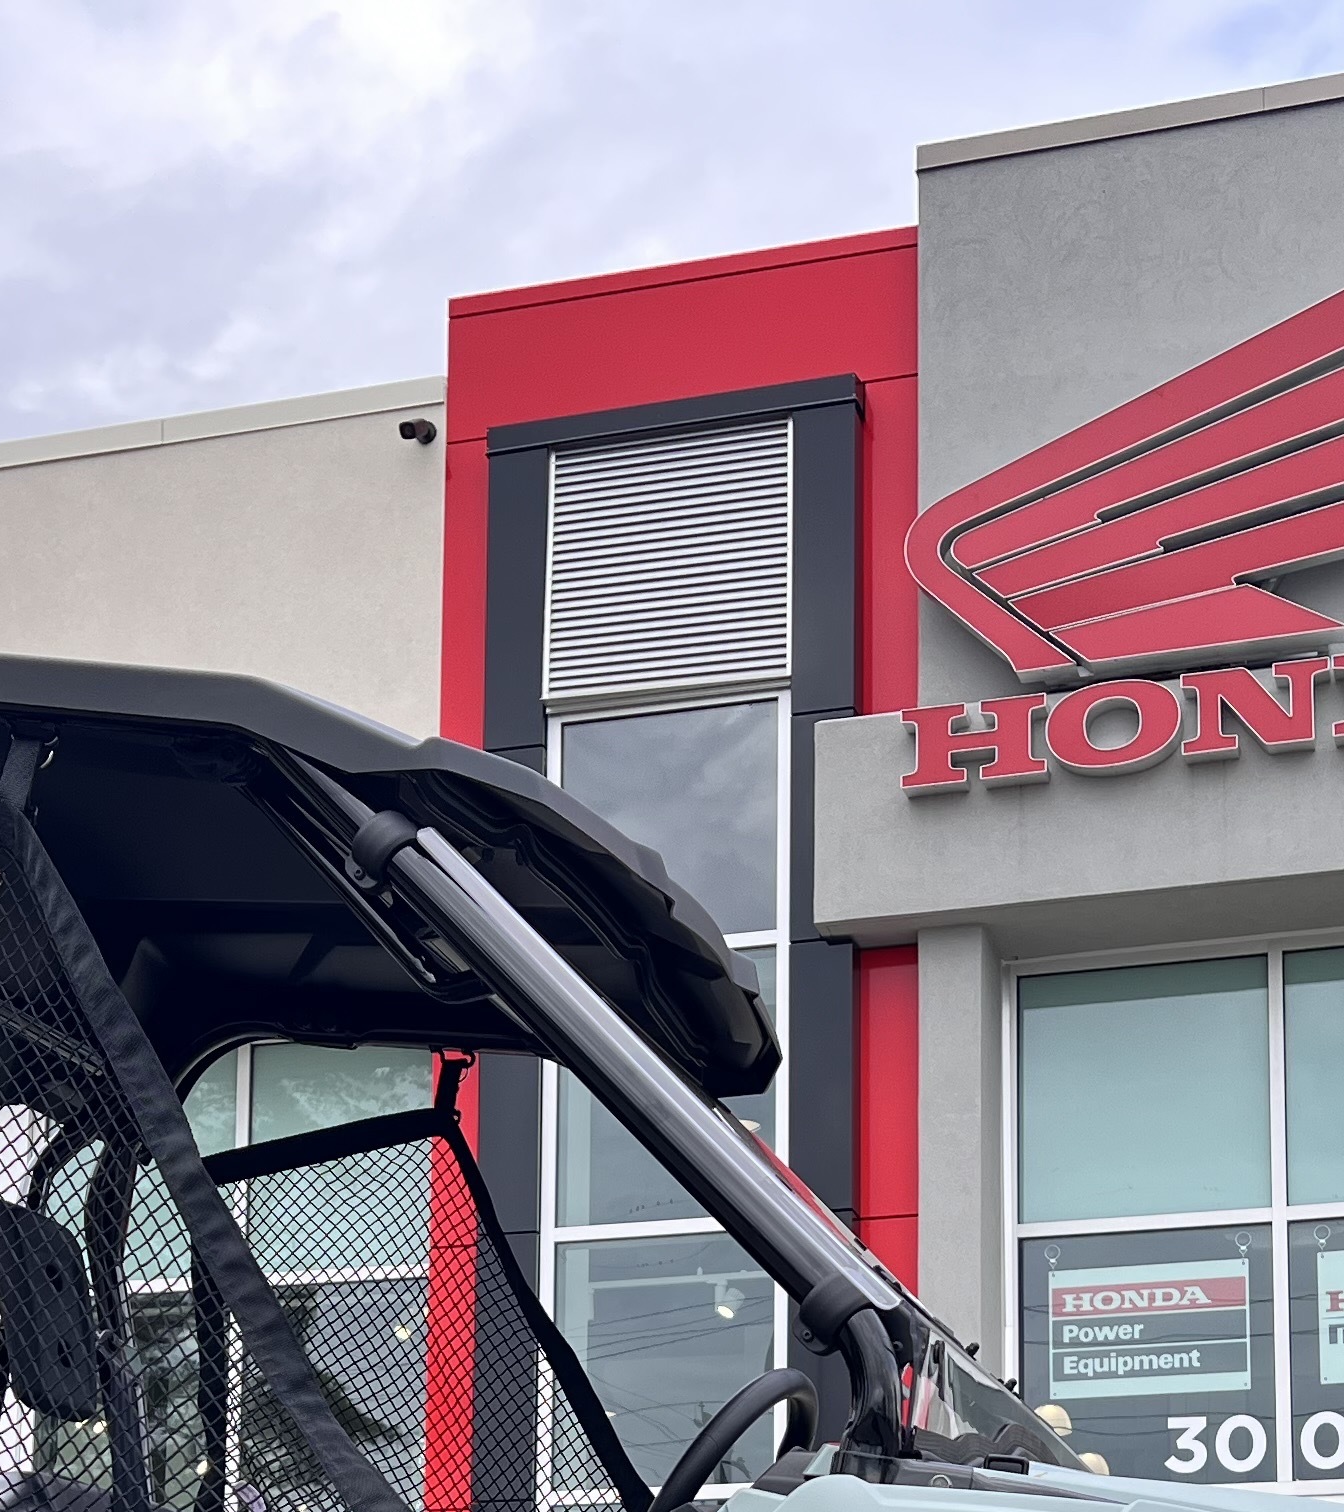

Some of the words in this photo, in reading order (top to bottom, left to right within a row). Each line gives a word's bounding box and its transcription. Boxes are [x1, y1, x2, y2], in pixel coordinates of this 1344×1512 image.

[1061, 1285, 1212, 1313] HONDA
[1062, 1320, 1145, 1344] Power
[1063, 1348, 1201, 1377] Equipment
